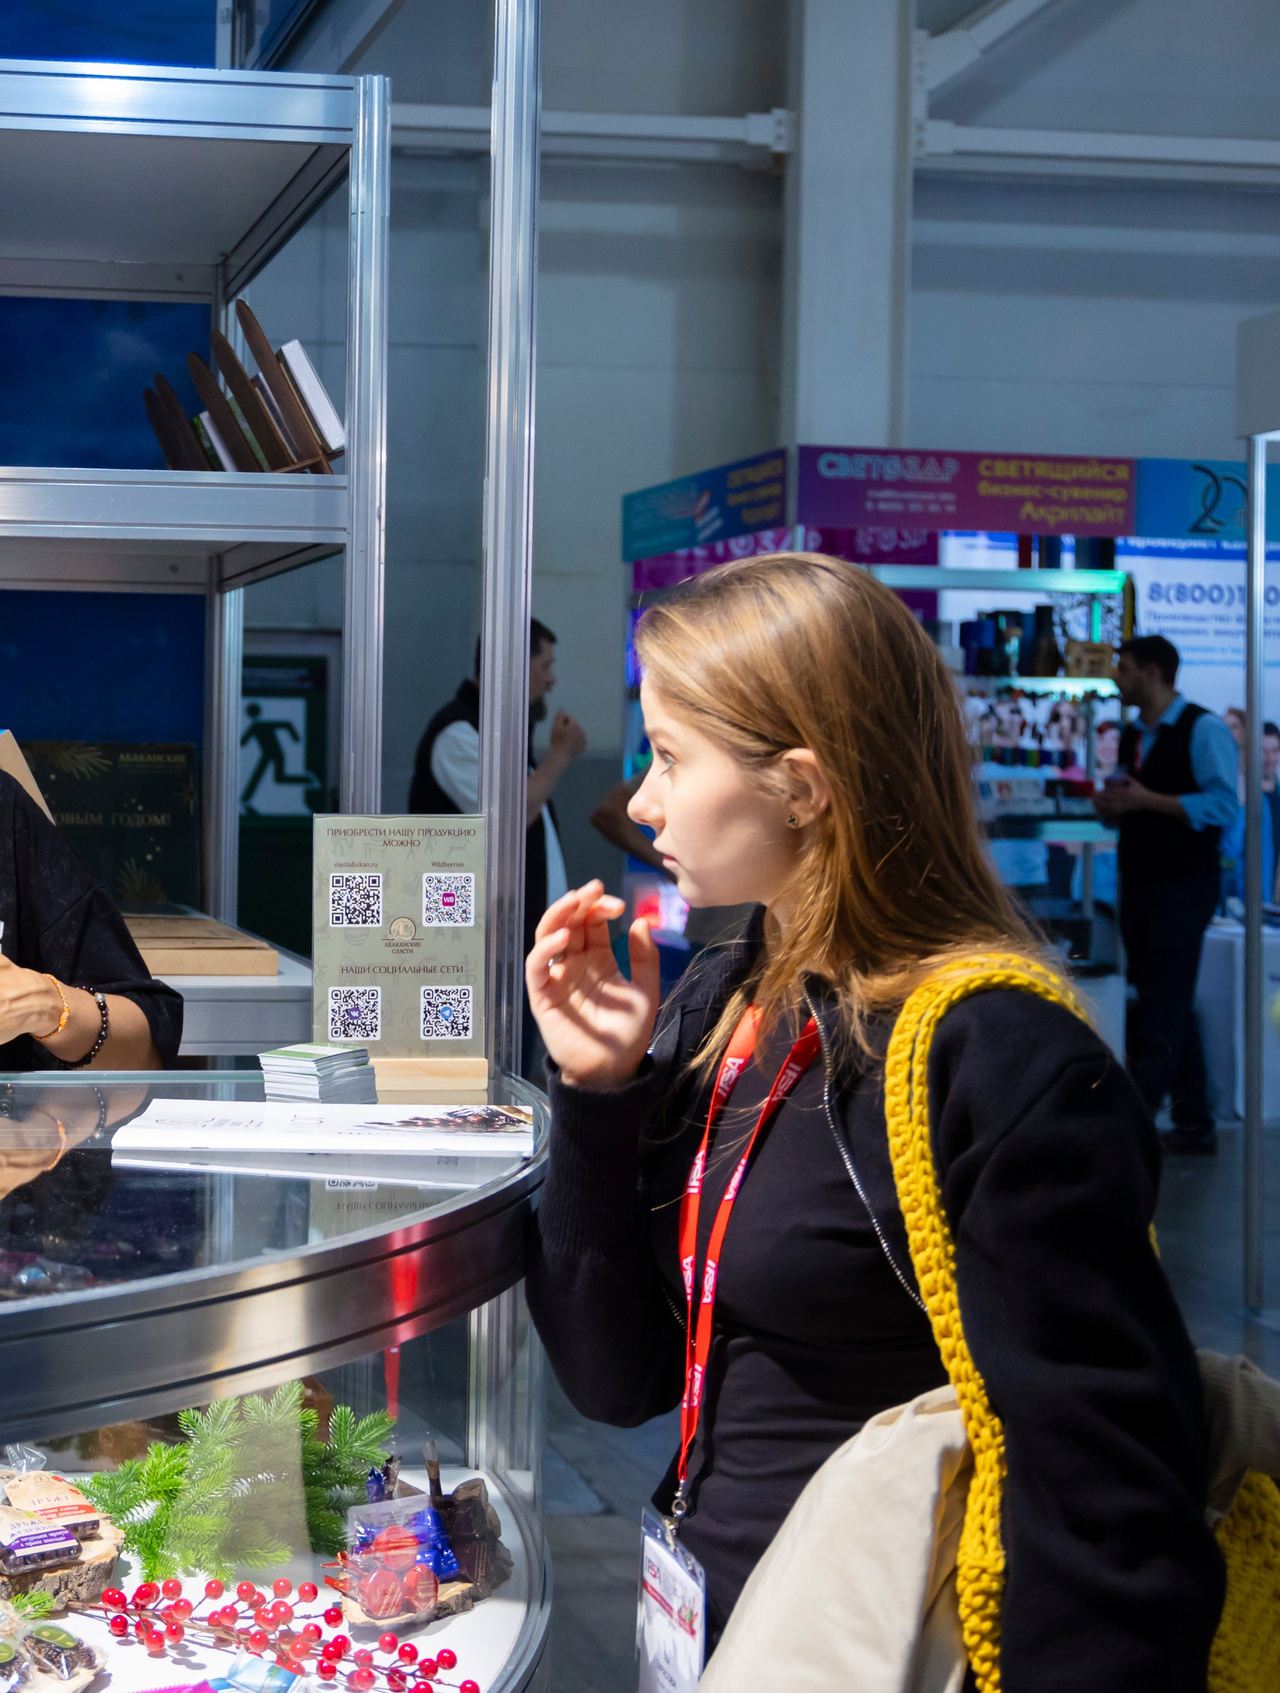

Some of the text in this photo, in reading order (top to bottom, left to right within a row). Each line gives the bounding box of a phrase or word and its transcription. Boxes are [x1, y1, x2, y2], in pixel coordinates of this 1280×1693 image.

[53, 813, 170, 827] ОВЫМ ГОДОМ!
[327, 829, 476, 838] ПРИОБРЕСТИ НАШУ ПРОДУКЦИЮ
[382, 839, 421, 848] МОЖНО
[341, 965, 464, 975] НАШИ СОЦИАЛЬНЫЕ СЕТИ
[718, 1057, 745, 1097] IFSA
[687, 1150, 705, 1193] IFSA
[702, 1259, 716, 1303] IFSA
